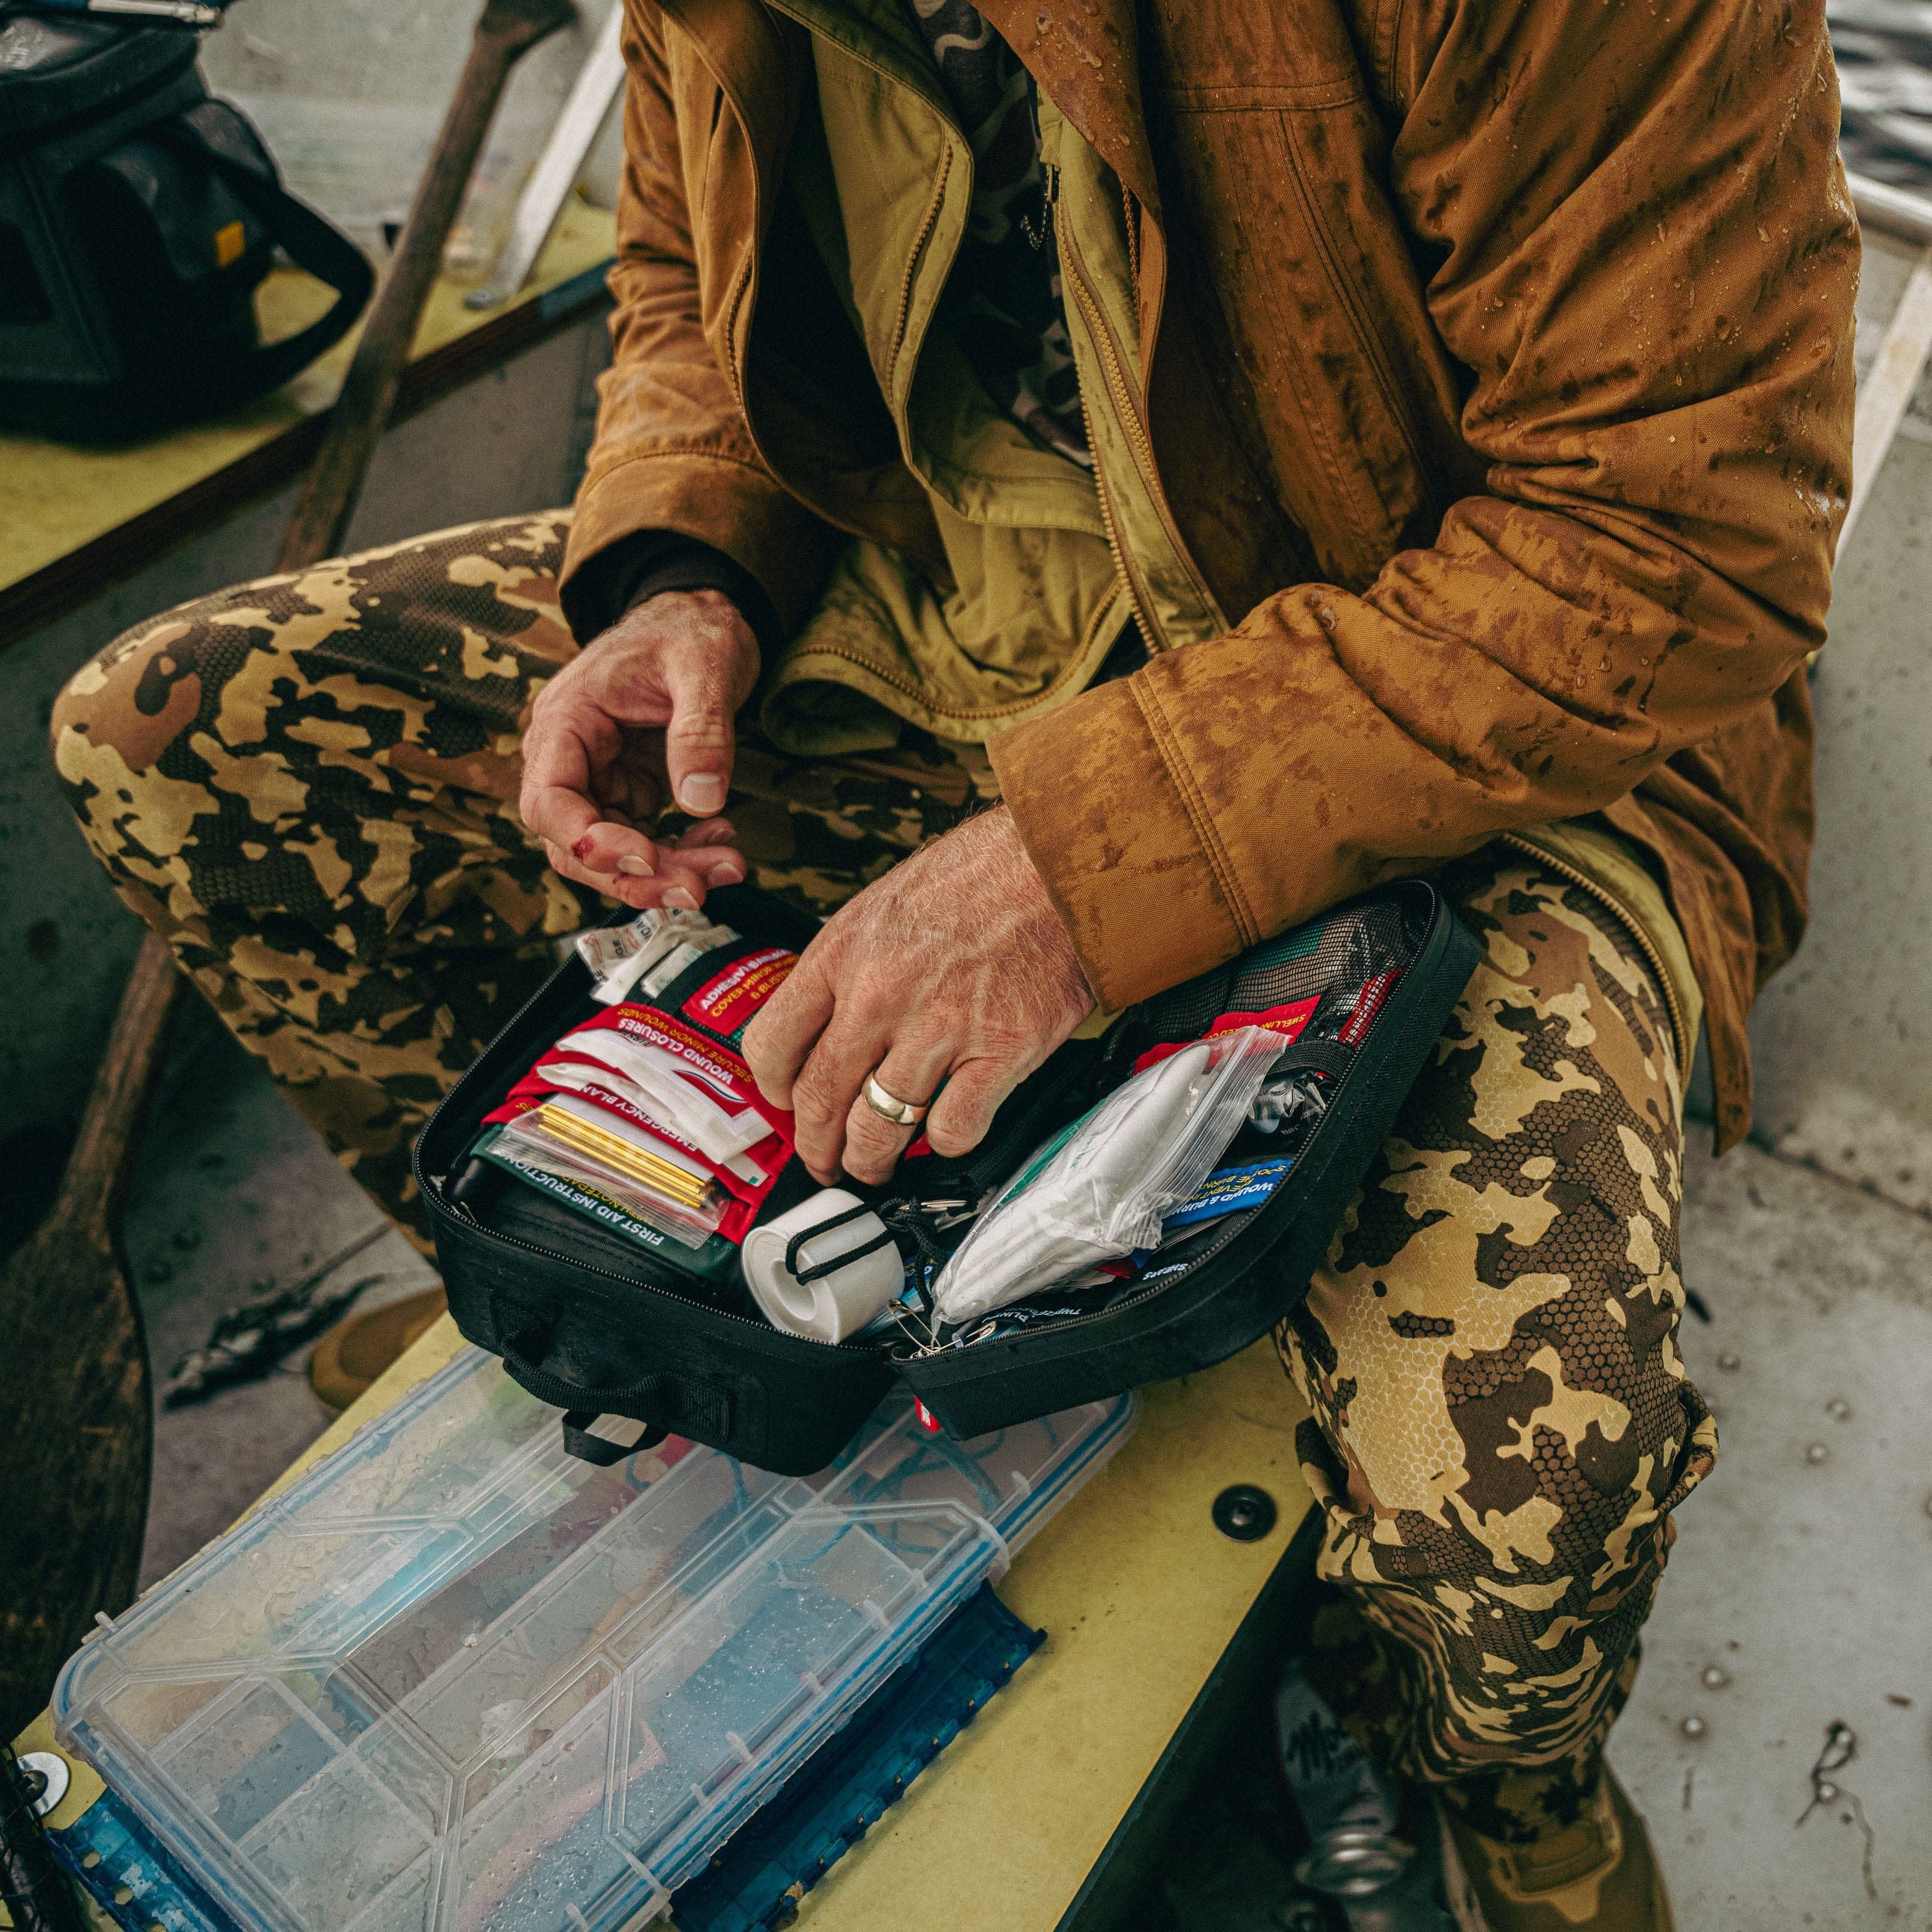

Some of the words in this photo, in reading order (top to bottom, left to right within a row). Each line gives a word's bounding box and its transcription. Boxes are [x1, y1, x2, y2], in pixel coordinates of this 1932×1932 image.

[710, 986, 745, 1016] COVER
[743, 964, 773, 991] MINOR
[617, 1010, 669, 1032] WOUNDS
[617, 1016, 684, 1052] CLOSURES
[669, 1027, 709, 1054] MINOR
[683, 1046, 735, 1085] WOUND
[707, 1049, 754, 1083] SECURE
[580, 1083, 619, 1104] BLAN
[502, 1153, 598, 1209] INSTRUCTION
[1219, 1181, 1273, 1203] WOUND
[595, 1203, 626, 1224] AID
[1209, 1195, 1220, 1205] &
[620, 1217, 664, 1246] FIRST
